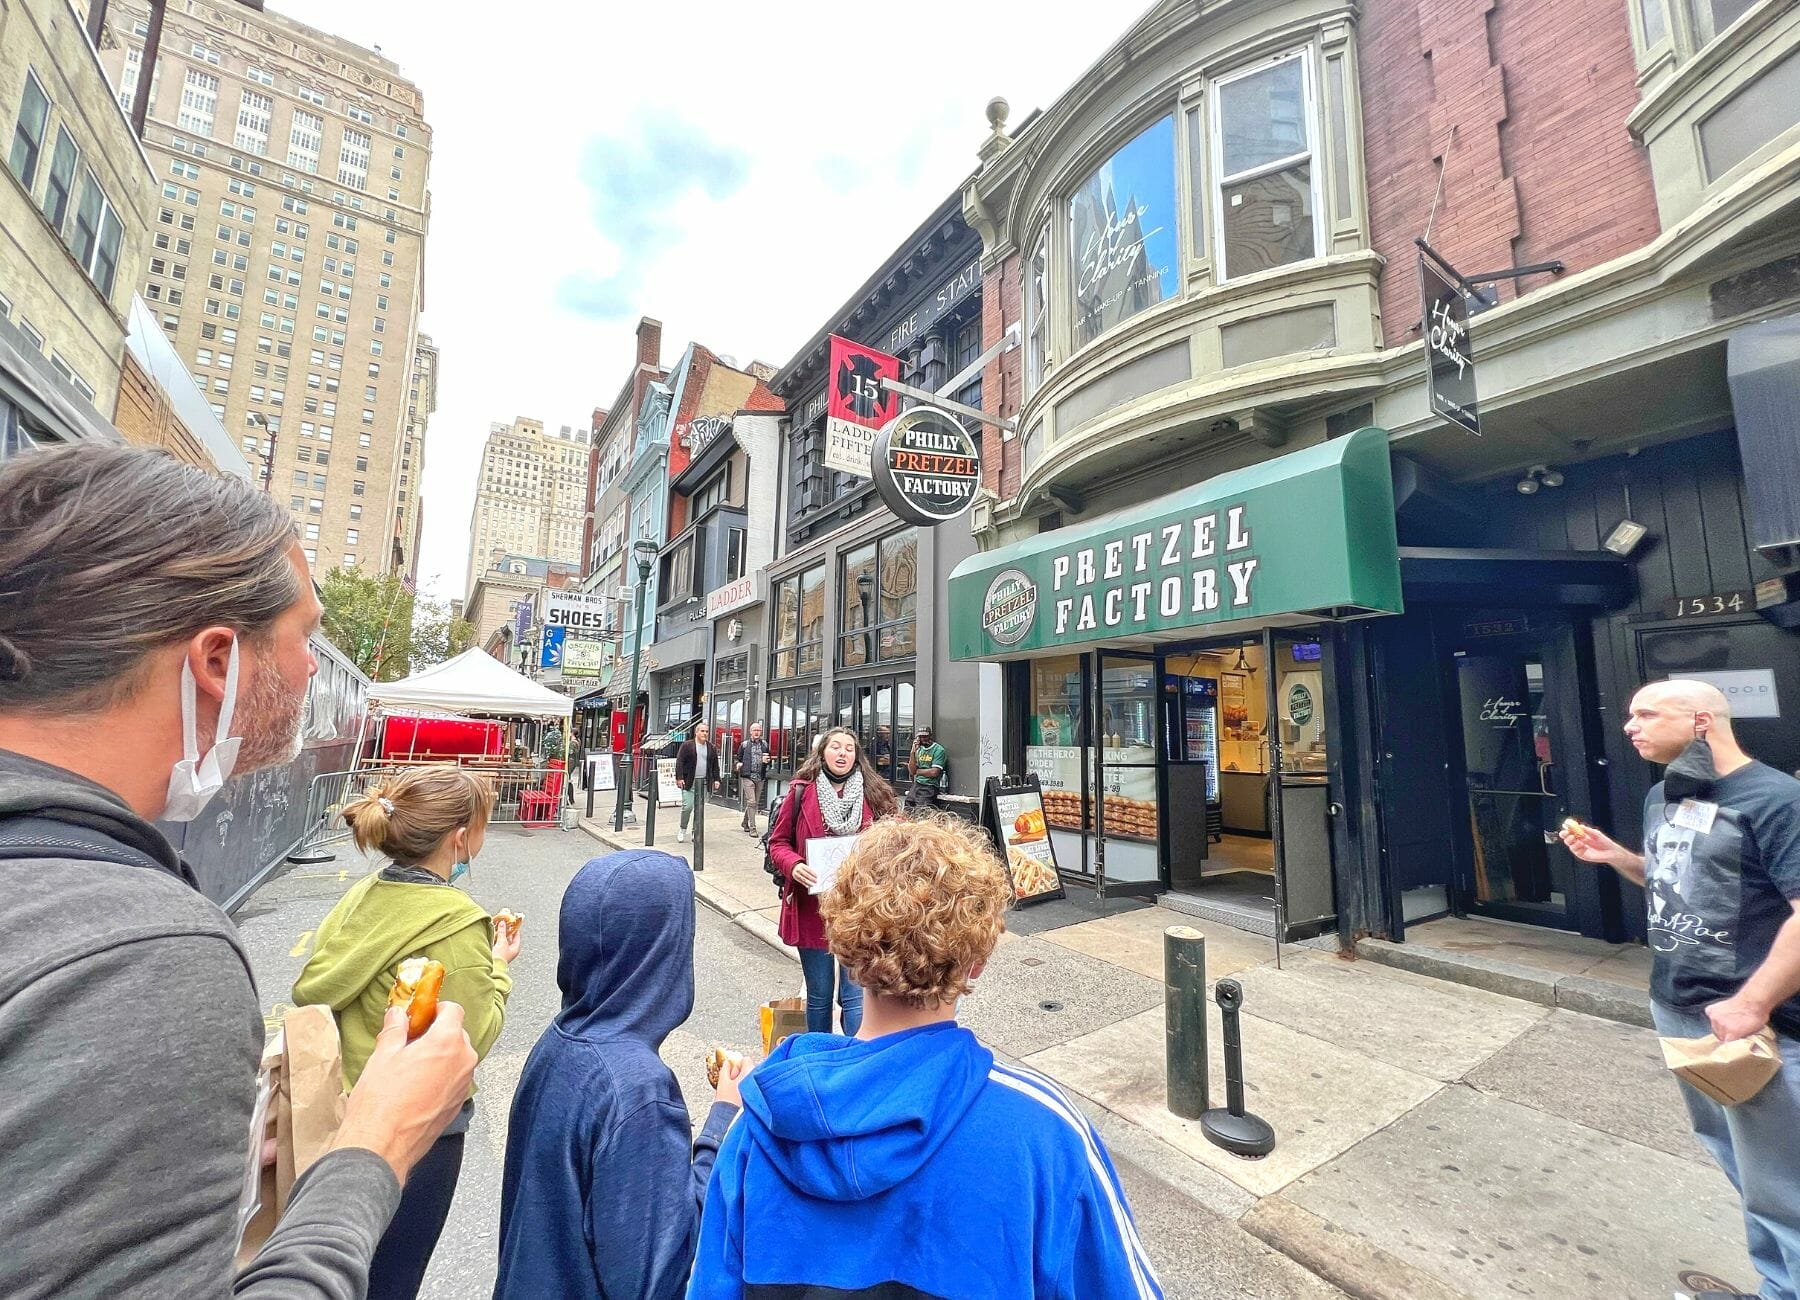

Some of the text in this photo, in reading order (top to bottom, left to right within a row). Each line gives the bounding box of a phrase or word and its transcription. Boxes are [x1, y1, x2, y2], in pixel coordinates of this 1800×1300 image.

[1077, 226, 1164, 298] Clarity
[1134, 265, 1169, 289] TANNING
[890, 312, 918, 350] FIRE
[1430, 325, 1473, 381] Clarity
[852, 374, 879, 400] 15
[808, 396, 829, 418] PHIL
[832, 435, 872, 456] FIFTE
[904, 430, 960, 451] PHILLY
[894, 451, 976, 475] PRETZEL
[903, 476, 973, 497] FACTORY
[1053, 506, 1249, 592] PRETZEL
[551, 592, 582, 602] SHERMAN
[711, 580, 752, 612] LADDER
[991, 579, 1021, 605] PHILLY
[1055, 559, 1258, 635] FACTORY
[987, 590, 1031, 624] PRETZEL
[1677, 593, 1744, 618] 1534
[549, 608, 603, 628] SHOES
[994, 606, 1032, 637] FACTORY
[1483, 696, 1521, 710] House
[1480, 709, 1528, 726] Clarity
[1028, 759, 1054, 769] ORDER
[1040, 749, 1053, 758] THE
